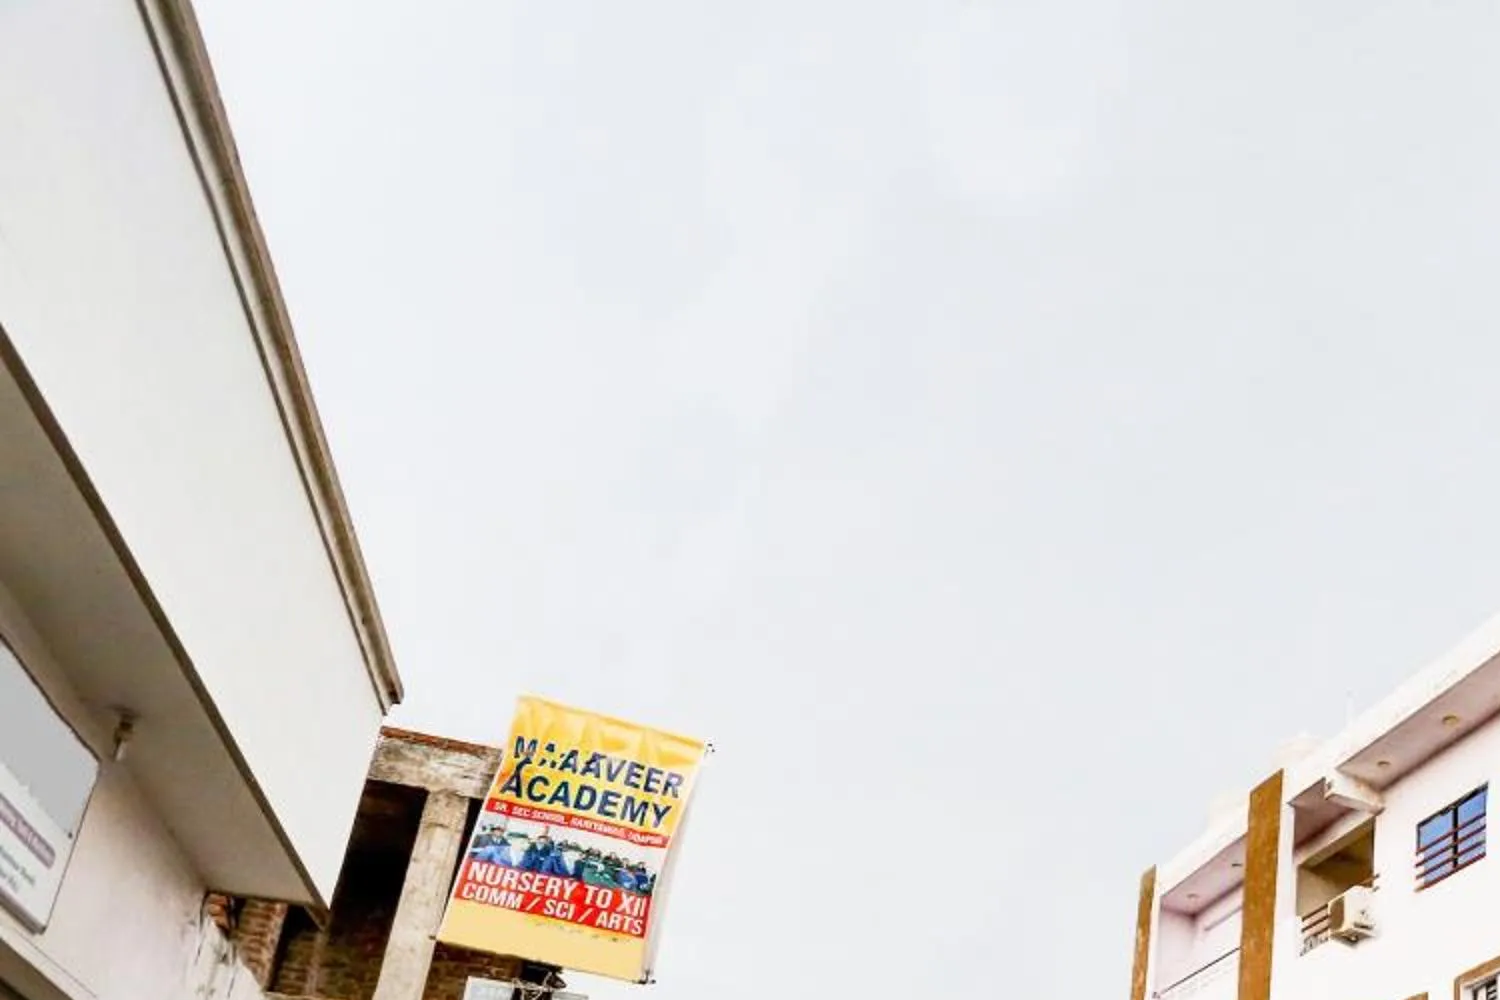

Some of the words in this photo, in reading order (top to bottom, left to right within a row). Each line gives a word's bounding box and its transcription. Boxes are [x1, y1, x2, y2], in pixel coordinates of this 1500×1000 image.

[500, 758, 672, 828] ACADEMY
[462, 882, 523, 910] COMM
[543, 899, 575, 920] SCI
[595, 911, 643, 935] ARTS
[469, 861, 580, 900] NURSERY
[583, 882, 613, 909] TO
[617, 890, 647, 917] XII
